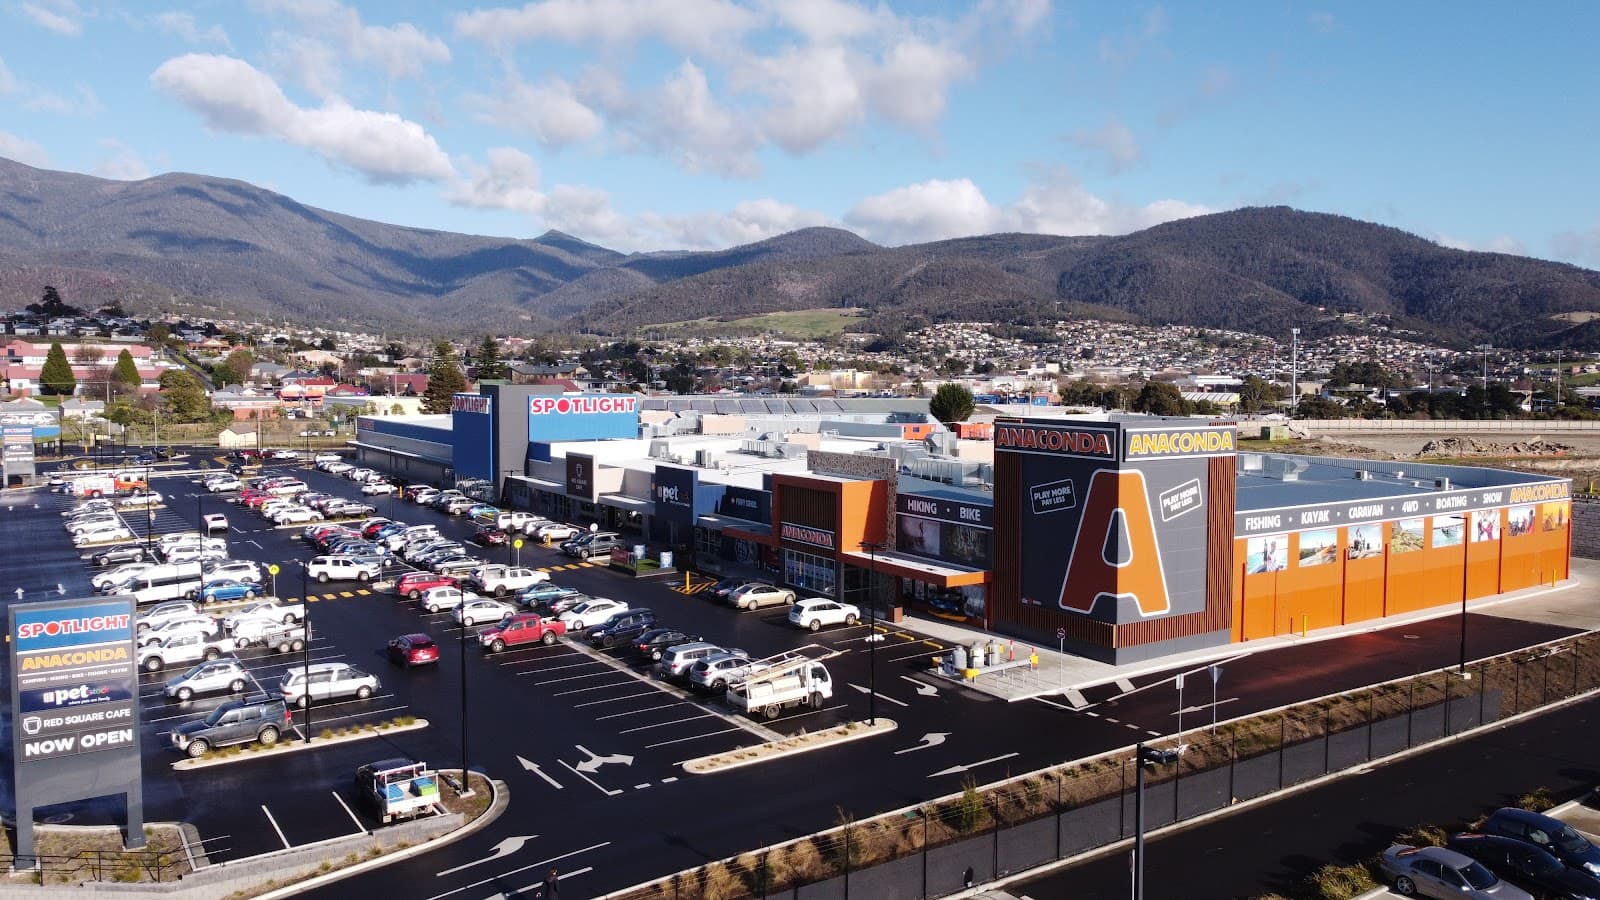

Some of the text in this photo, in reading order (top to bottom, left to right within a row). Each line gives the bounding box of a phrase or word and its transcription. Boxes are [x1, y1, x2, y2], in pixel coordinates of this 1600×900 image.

[452, 395, 490, 414] SPOTLIGHT
[530, 396, 636, 415] SPOTLIGHT
[997, 428, 1112, 454] ANACONDA
[1129, 431, 1233, 455] ANACONDA
[1033, 486, 1071, 500] PLAY MORE
[1041, 496, 1065, 506] PAY LESS
[1163, 486, 1198, 508] PLAY MORE
[907, 499, 981, 521] HIKING BIKE
[1245, 483, 1569, 531] FISHING KAYAK CARAVAN 4WD BOATING SNOW ANACONDA
[781, 525, 832, 546] ANACONDA
[18, 615, 129, 638] SPOTLIGHT
[22, 648, 128, 671] ANACONDA
[43, 708, 131, 728] RED SQUARE CAFE
[25, 729, 133, 756] NOW OPEN
